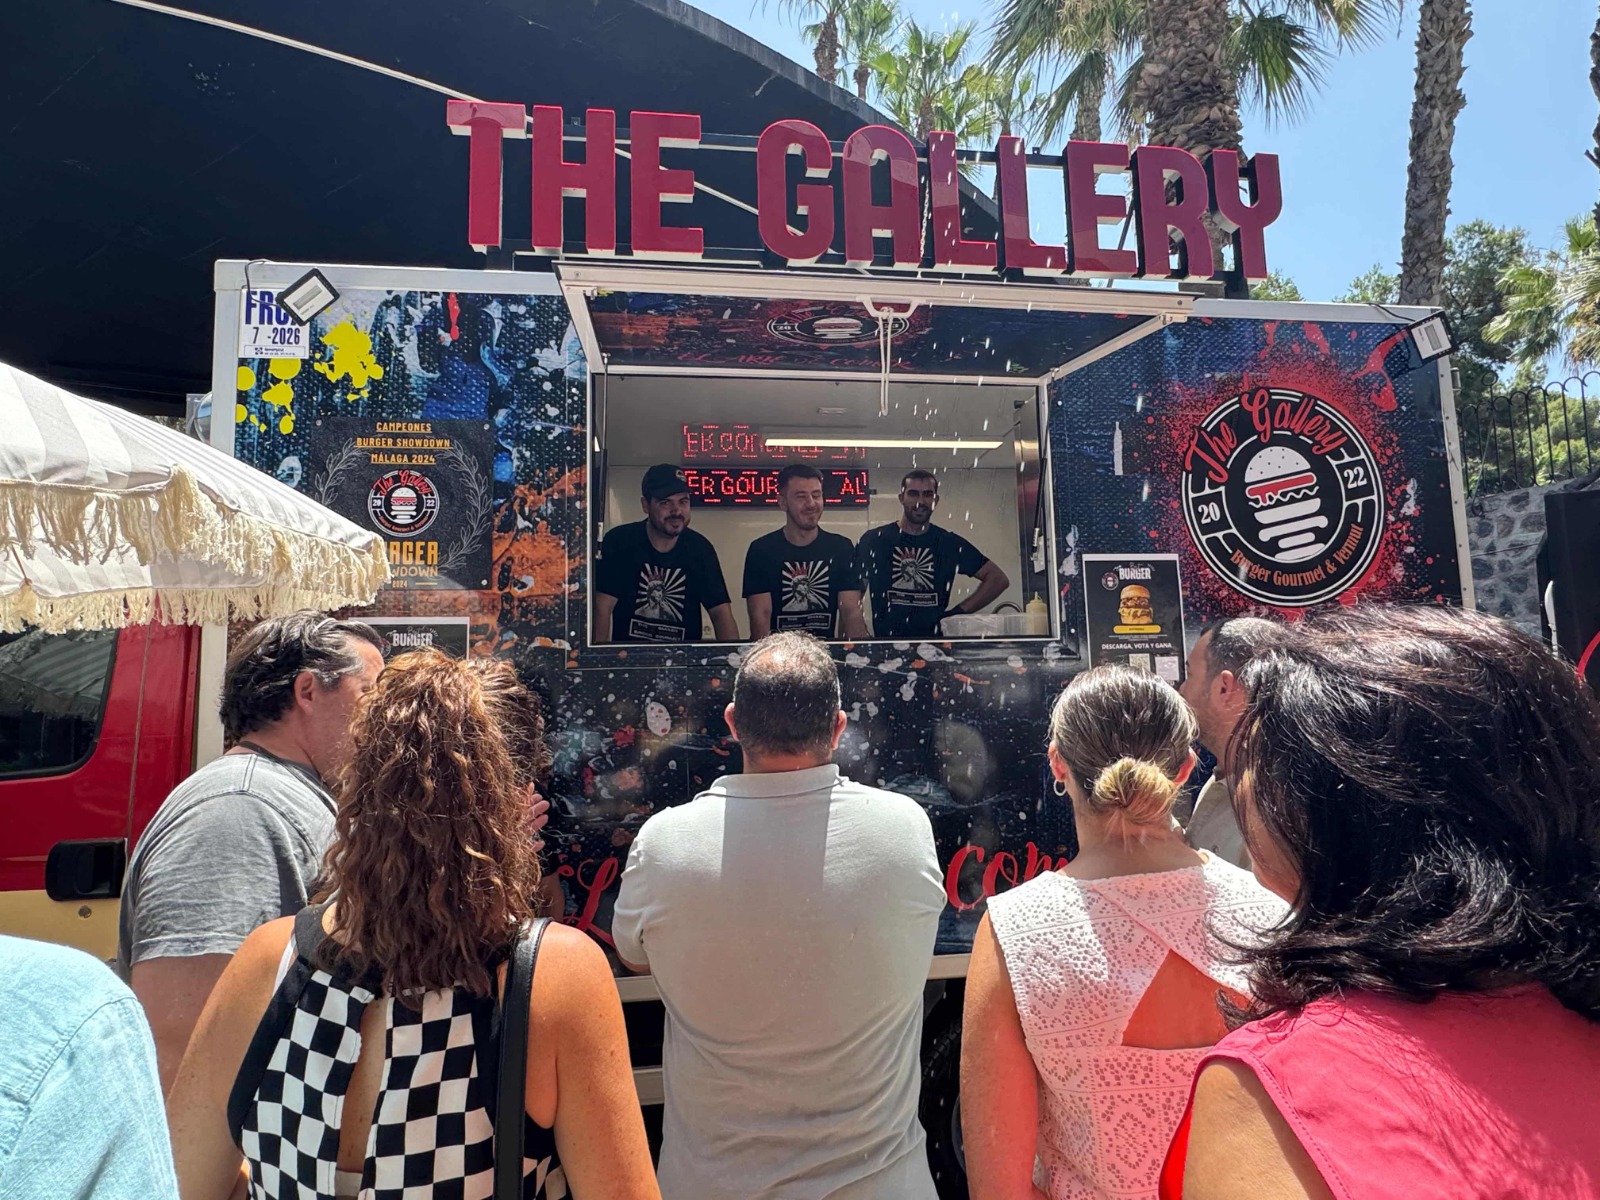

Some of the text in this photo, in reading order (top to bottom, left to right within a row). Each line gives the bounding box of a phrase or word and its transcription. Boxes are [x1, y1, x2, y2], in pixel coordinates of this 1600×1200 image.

[446, 100, 1281, 280] THE GALLERY
[376, 422, 432, 432] CAMPEONES
[356, 437, 450, 448] BURGER SHOWDOWN
[1185, 389, 1348, 483] The Gallery
[412, 454, 435, 464] 2024
[1343, 466, 1368, 488] 22
[426, 499, 436, 507] 22
[1198, 502, 1221, 524] 20
[386, 541, 438, 565] RGER
[1230, 522, 1364, 587] Burger Gourmet & Vermut
[1119, 567, 1152, 580] BURGER
[392, 633, 434, 647] BURGER
[1134, 642, 1150, 650] VOTA
